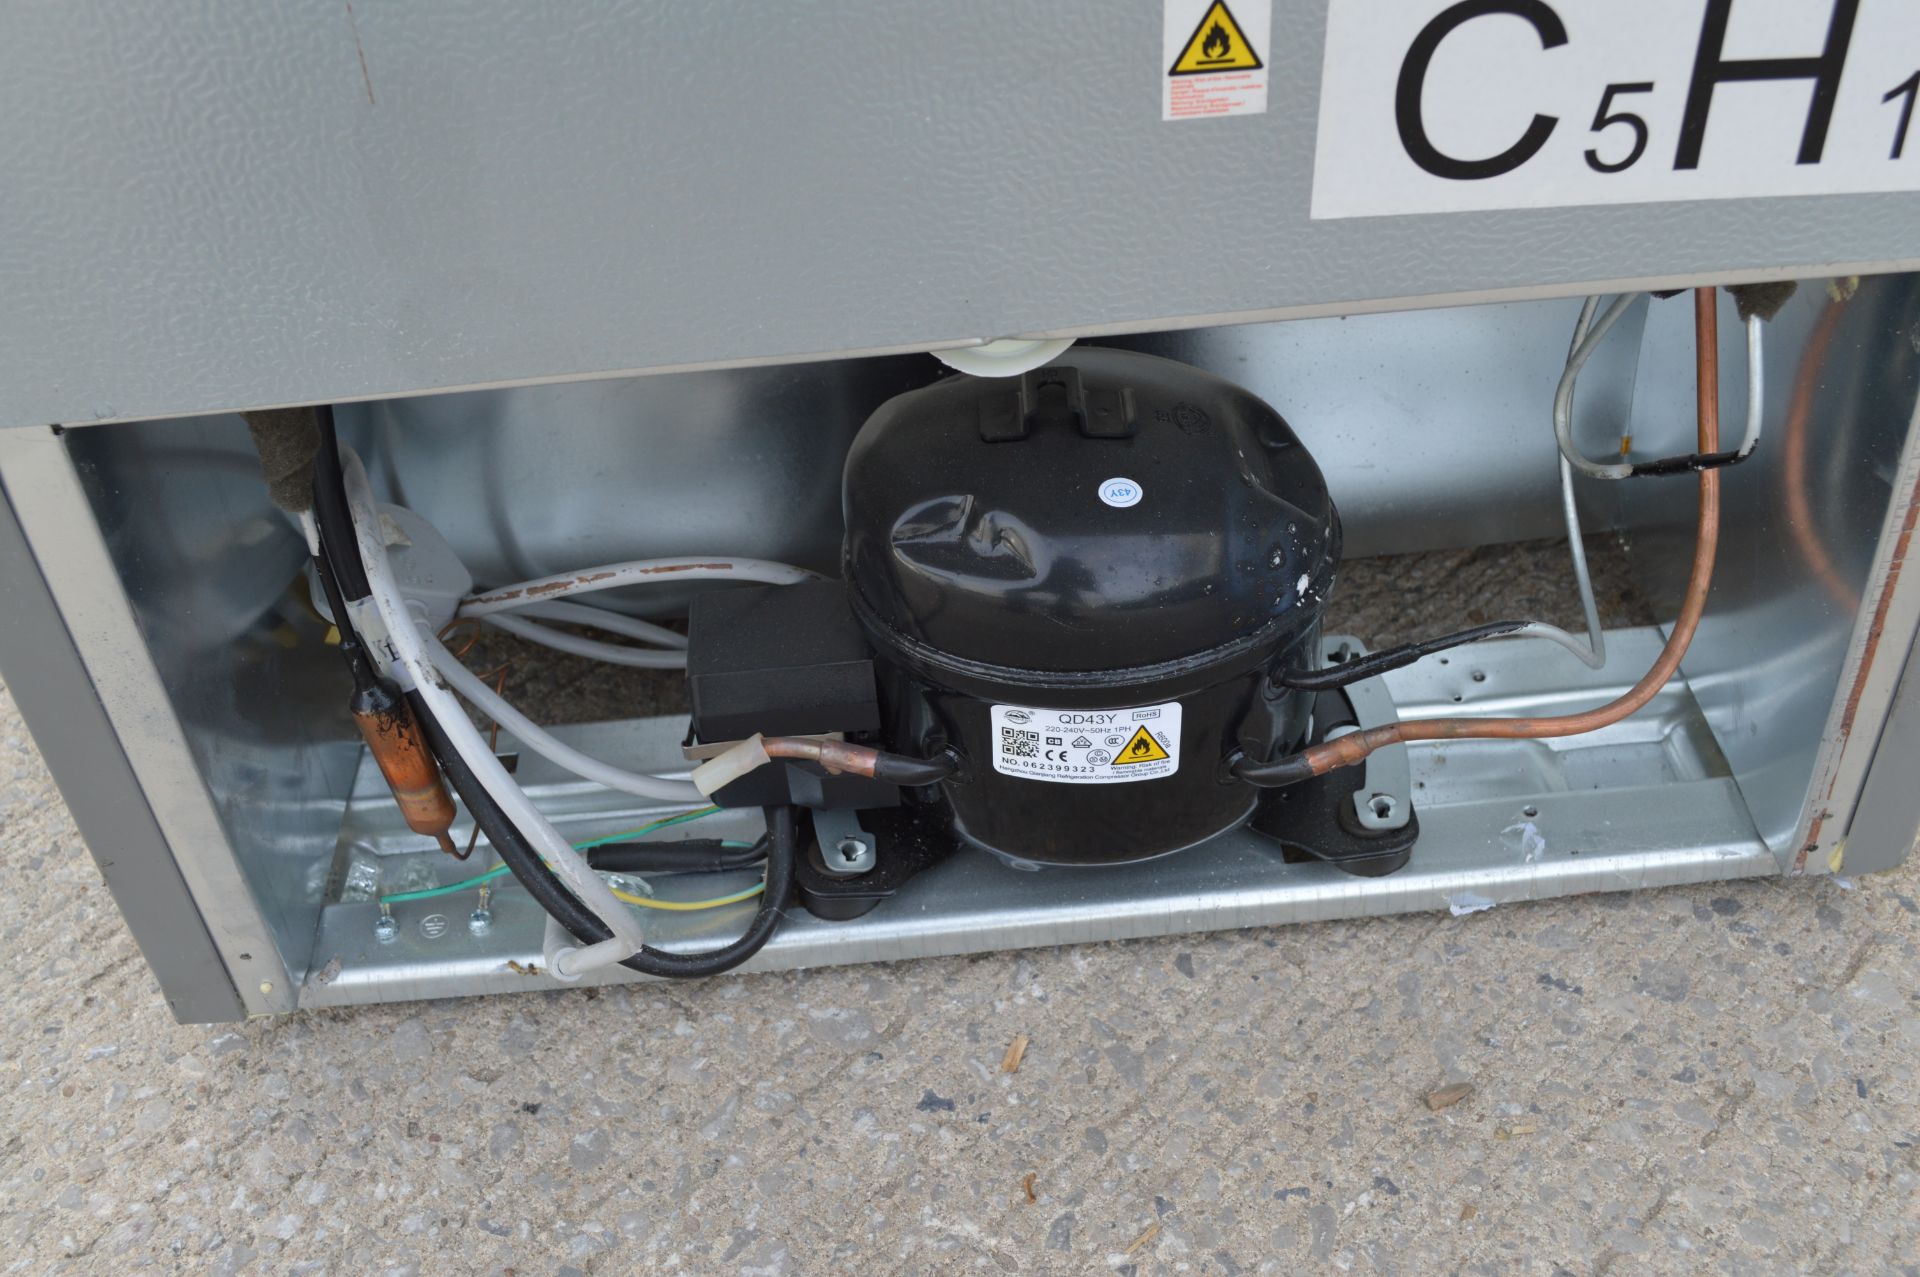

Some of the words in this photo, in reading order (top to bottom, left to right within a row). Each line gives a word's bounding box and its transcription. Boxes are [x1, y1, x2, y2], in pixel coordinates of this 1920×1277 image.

[1110, 488, 1132, 498] 43Y
[1058, 713, 1117, 725] QD43Y
[1136, 711, 1157, 719] RoHS
